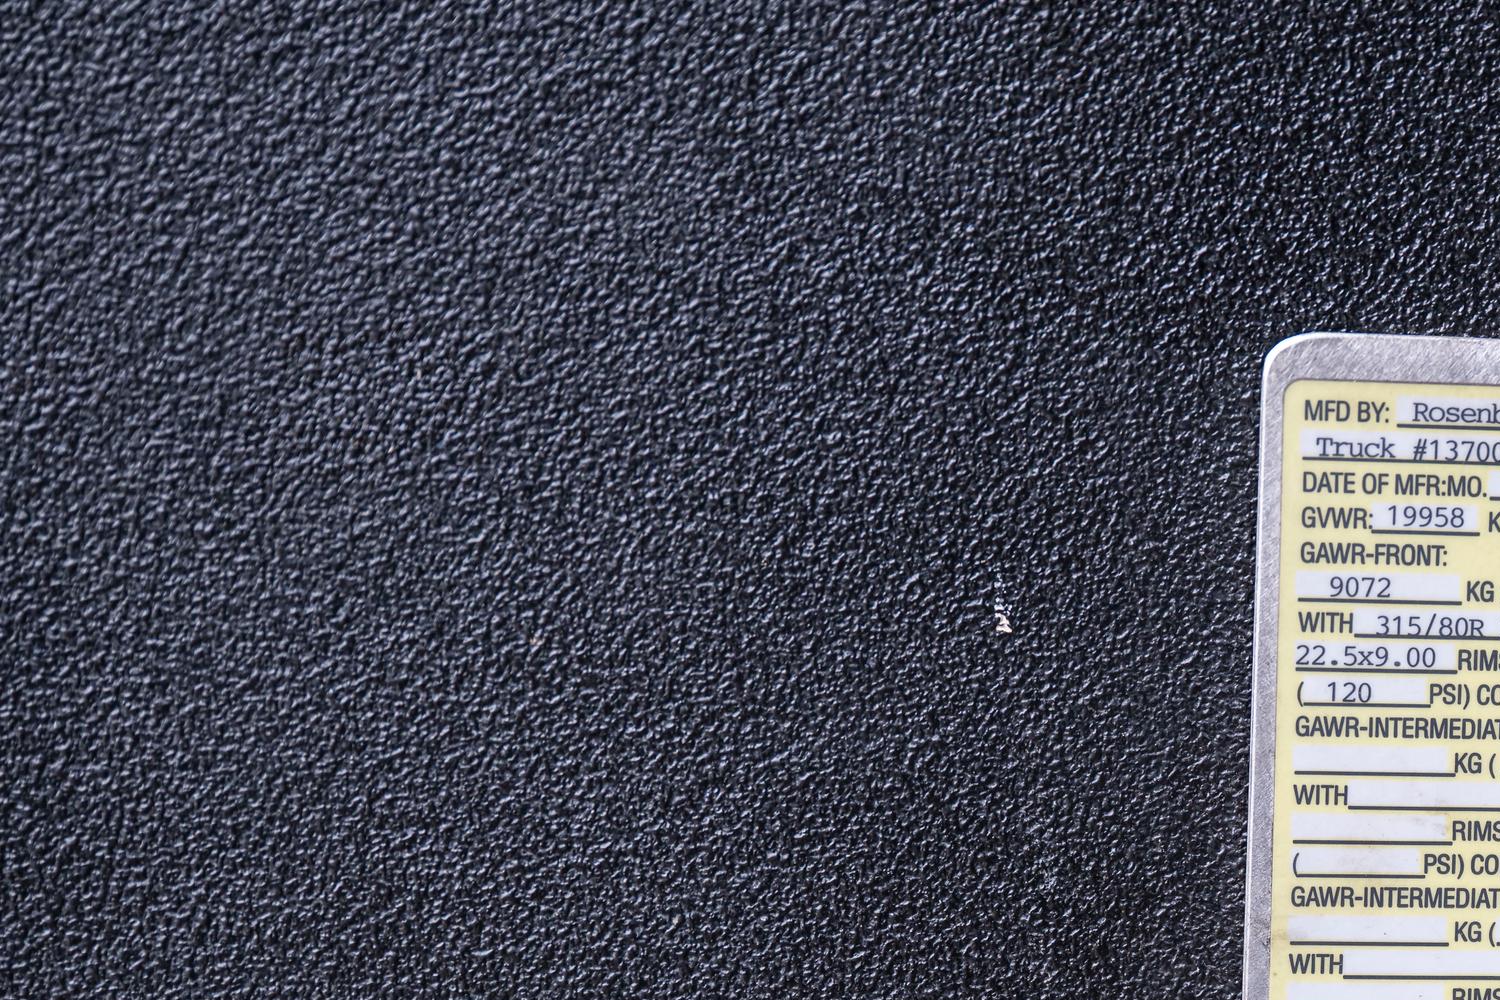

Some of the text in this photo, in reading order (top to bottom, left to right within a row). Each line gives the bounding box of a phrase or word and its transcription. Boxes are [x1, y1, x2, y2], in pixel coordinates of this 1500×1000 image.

[1304, 400, 1350, 422] MFD
[1357, 403, 1389, 423] BY:
[1316, 437, 1395, 458] Truck
[1302, 473, 1354, 494] DATE
[1362, 474, 1389, 495] OF
[1301, 507, 1372, 529] GVWR:
[1388, 506, 1465, 527] 19958
[1300, 544, 1447, 566] GAWR-FRONT:
[1330, 578, 1390, 597] 9072
[1467, 581, 1494, 602] KG
[1299, 613, 1353, 632] WITH
[1376, 616, 1484, 638] 315/80R
[1296, 646, 1436, 668] 22.5x9.00
[1328, 683, 1372, 703] 120
[1430, 685, 1470, 710] PSI)
[1454, 754, 1482, 774] KG
[1294, 786, 1348, 806] WITH
[1424, 855, 1464, 879] PSI)
[1455, 923, 1482, 942] KG
[1289, 955, 1343, 974] WITH
